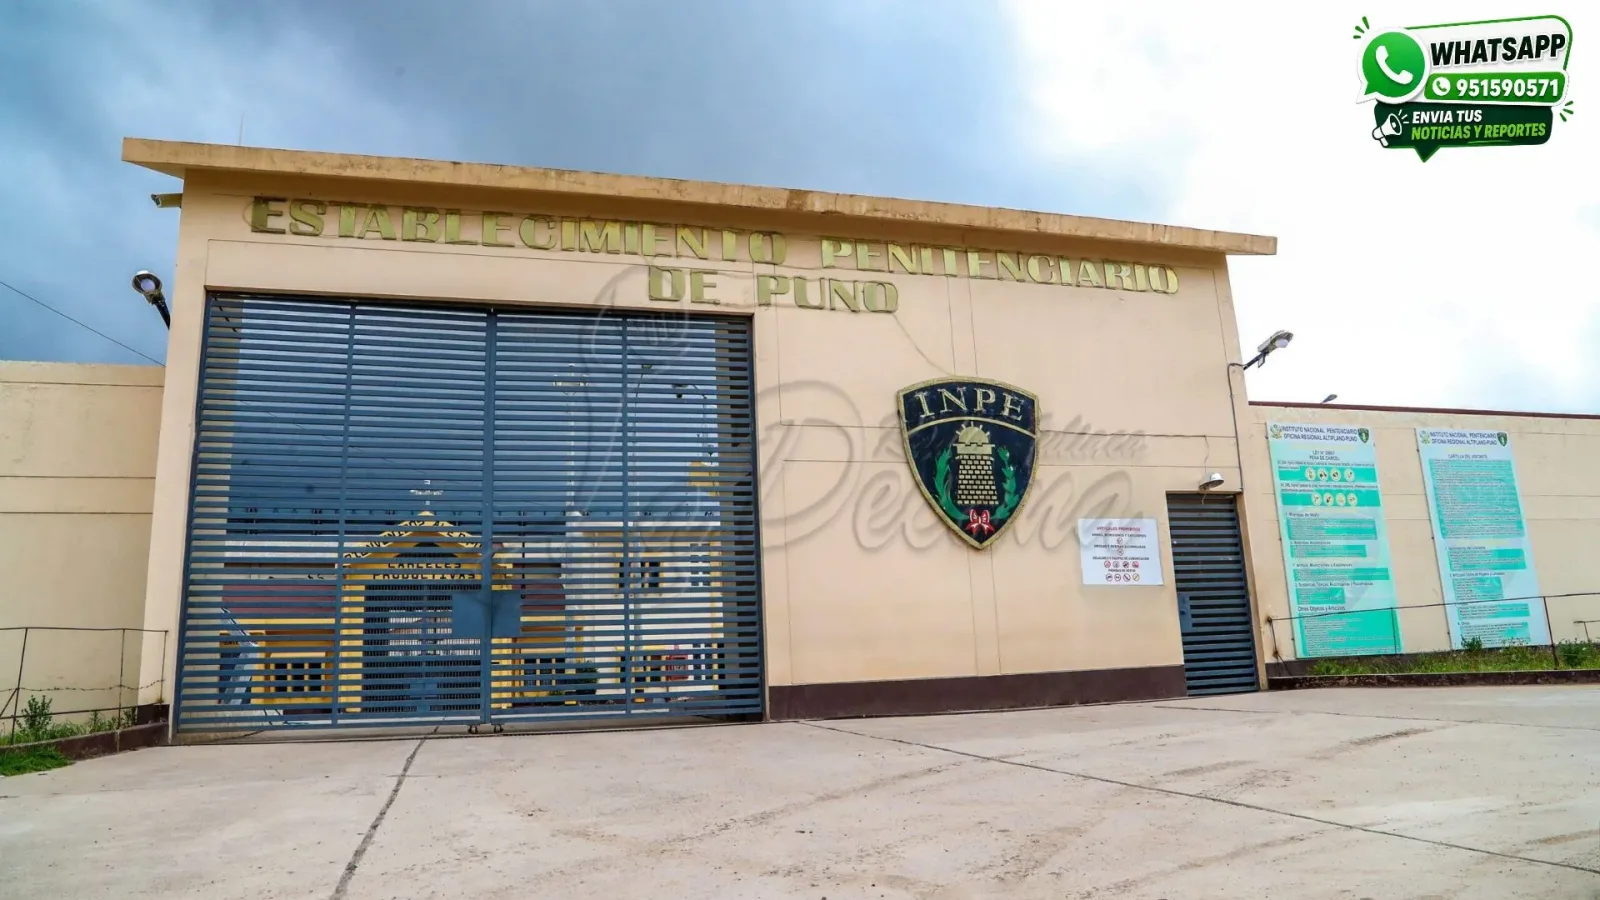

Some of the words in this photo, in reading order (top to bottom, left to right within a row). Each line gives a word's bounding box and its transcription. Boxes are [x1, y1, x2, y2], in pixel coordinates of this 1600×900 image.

[251, 195, 788, 265] ESTABLECIMIENTO
[821, 236, 1180, 295] PENITENCIARIO
[648, 265, 720, 306] DE
[756, 273, 900, 314] PUNO
[915, 386, 1025, 421] INPE
